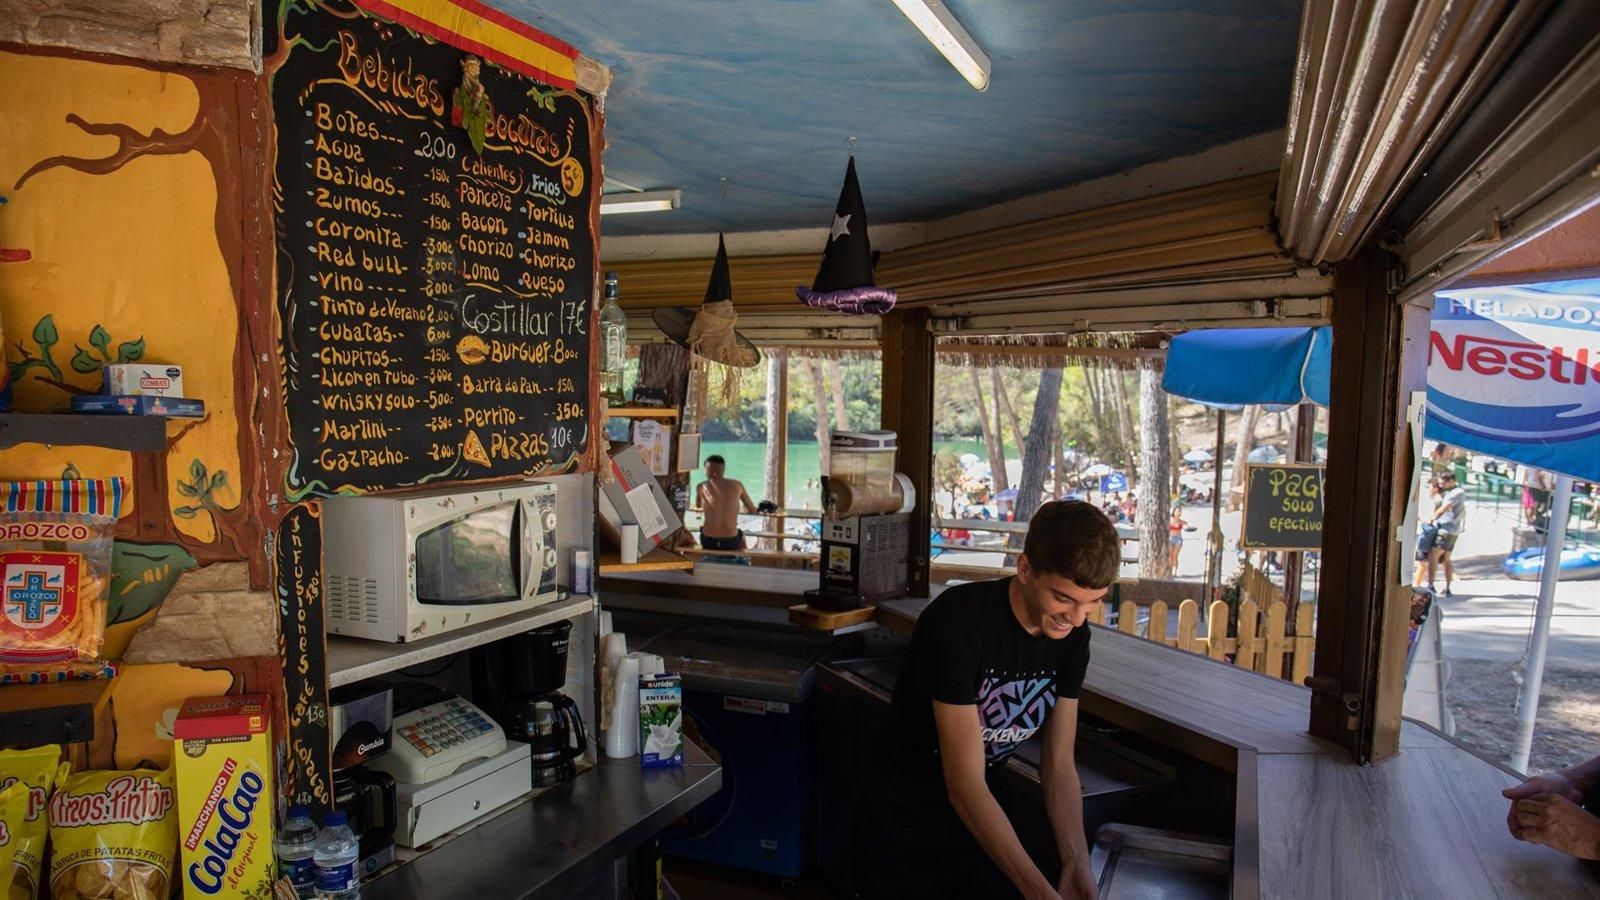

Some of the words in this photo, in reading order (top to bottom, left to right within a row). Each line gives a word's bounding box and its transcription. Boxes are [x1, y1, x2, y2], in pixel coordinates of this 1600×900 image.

[337, 29, 444, 116] Bebidas
[532, 173, 561, 196] Frios
[316, 187, 381, 218] Zumos
[461, 211, 508, 235] Bacon
[460, 234, 513, 258] Chorizo
[527, 226, 569, 250] Jamon
[318, 241, 356, 267] Red
[524, 248, 575, 271] Chorizo
[462, 260, 499, 281] Lomo
[523, 272, 565, 293] Queso
[462, 293, 554, 336] Costillar
[560, 300, 586, 335] 17€
[463, 374, 502, 395] Barra
[491, 429, 549, 461] Pizzas
[551, 426, 572, 449] 10€
[13, 592, 57, 600] OROZCO
[30, 576, 39, 619] OROZCO
[653, 680, 674, 688] unide
[251, 717, 260, 726] 50
[188, 770, 264, 895] ColaCao
[94, 846, 142, 857] PATATAS
[143, 849, 171, 870] FRITAS
